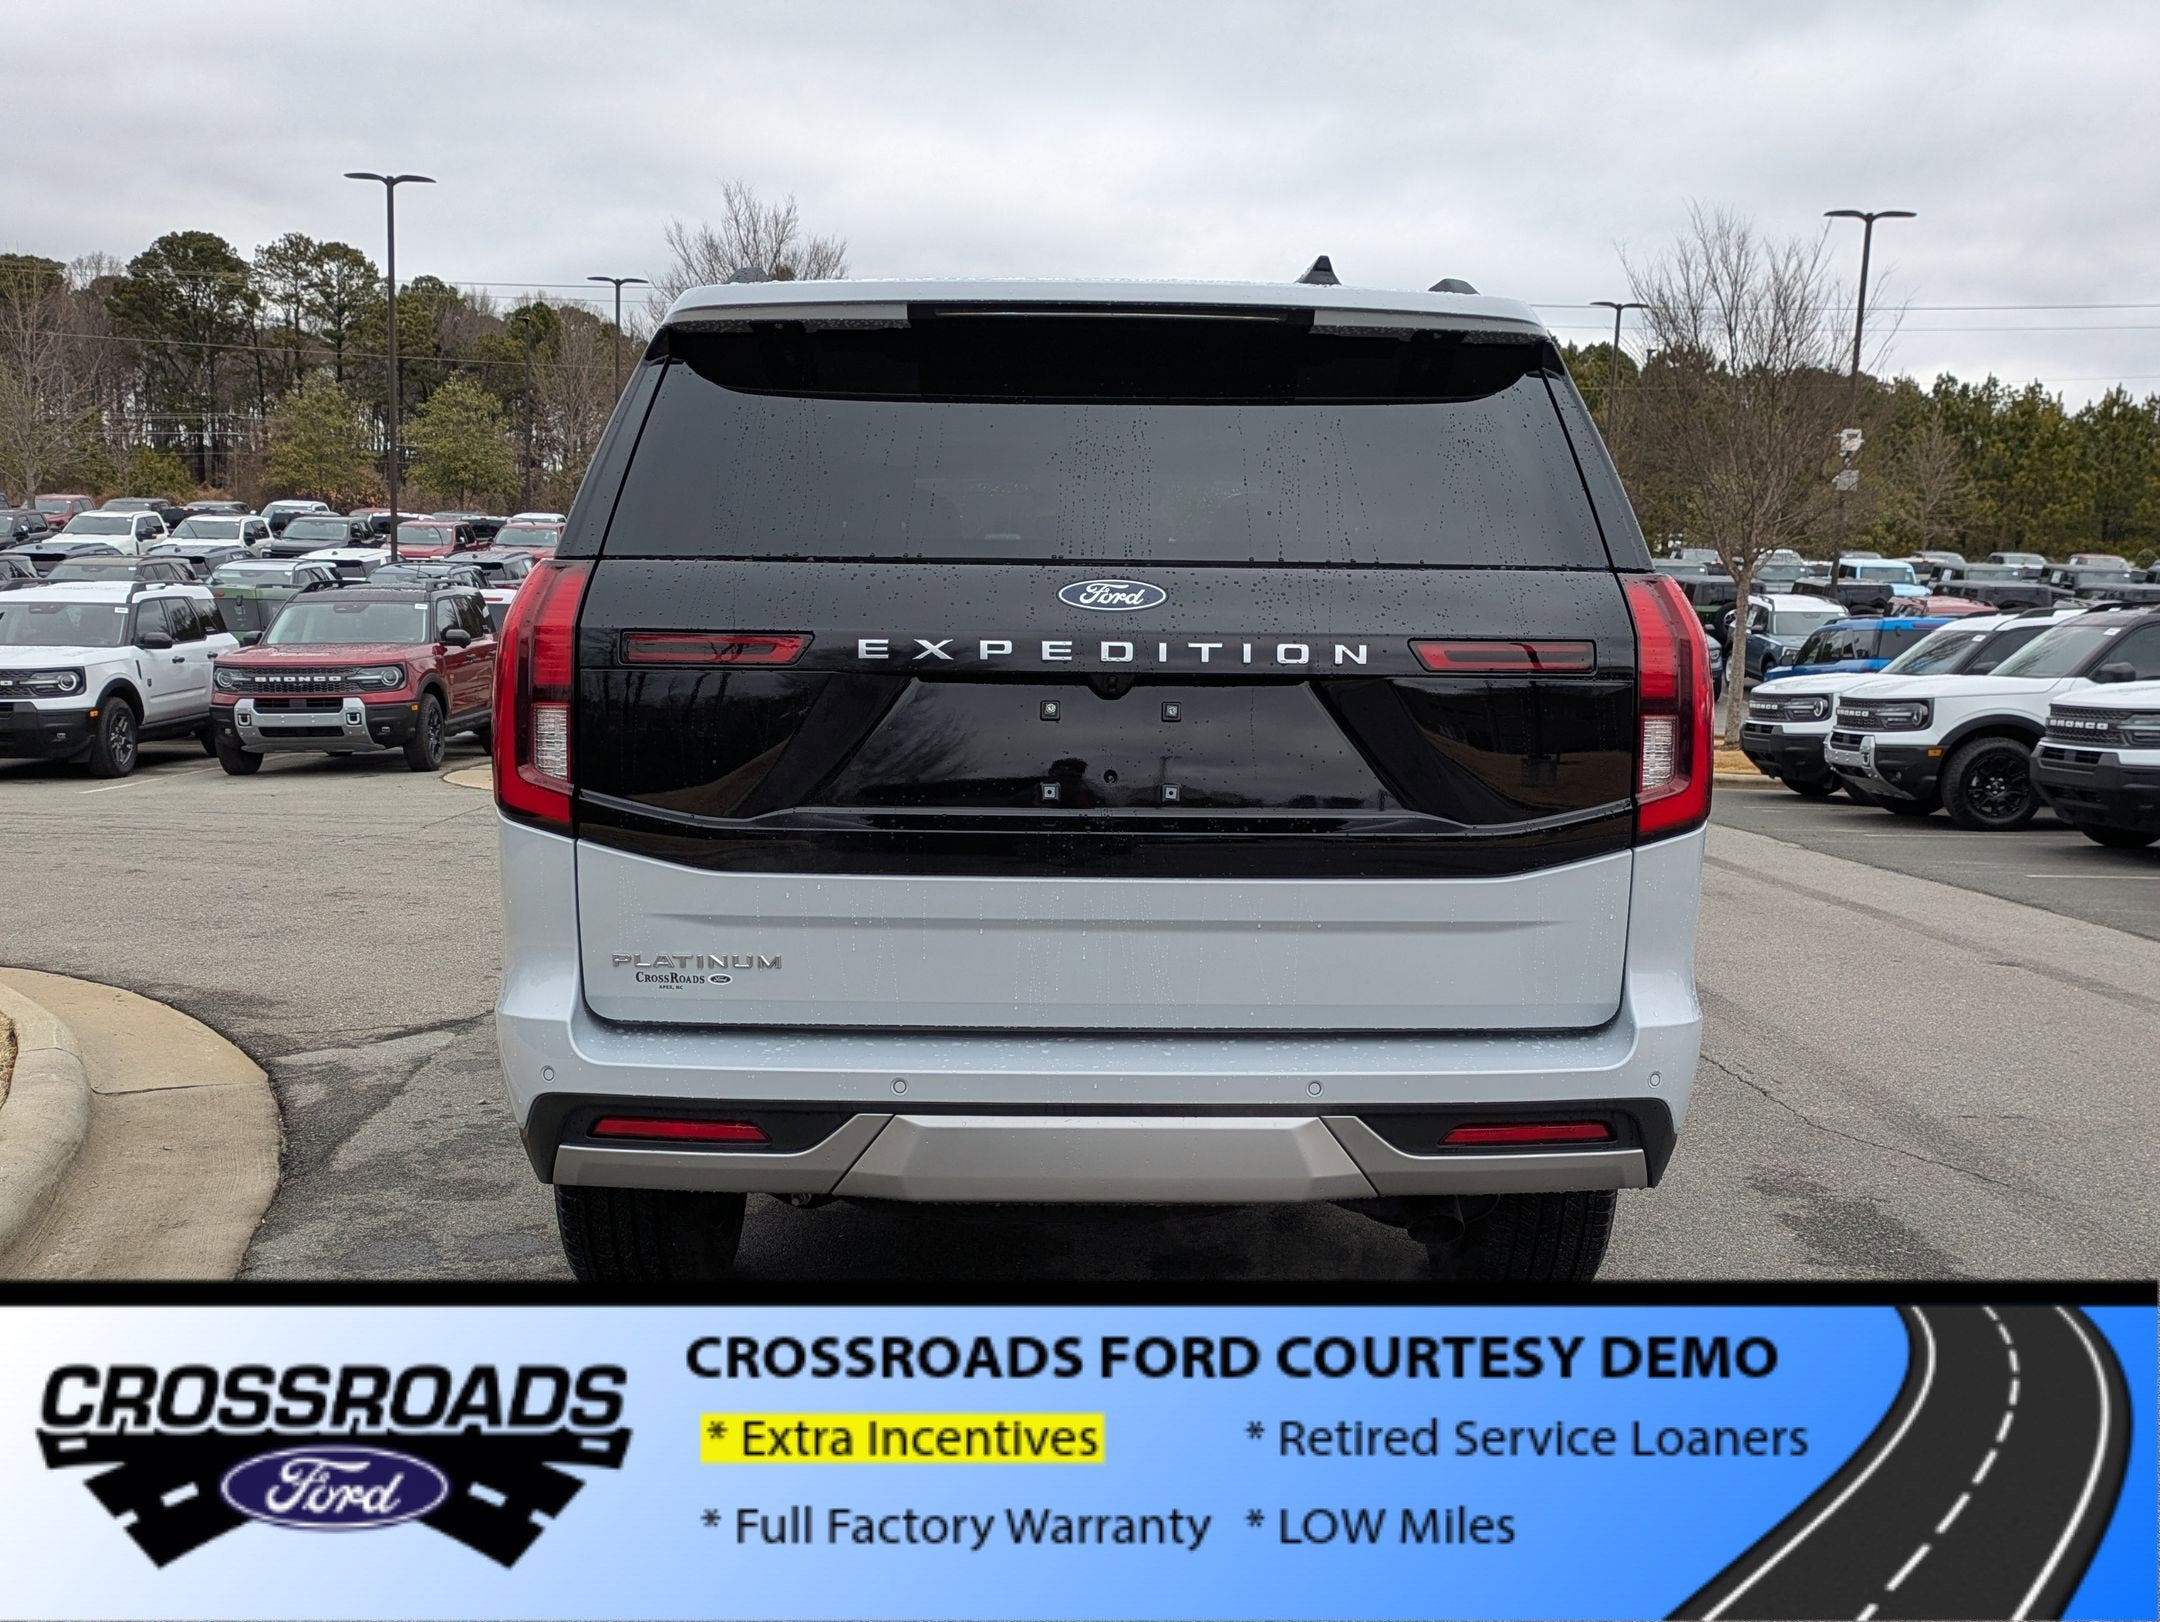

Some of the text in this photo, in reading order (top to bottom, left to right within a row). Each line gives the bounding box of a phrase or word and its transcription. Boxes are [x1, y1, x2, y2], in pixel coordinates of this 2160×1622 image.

[1079, 582, 1146, 605] Ford
[857, 637, 1368, 665] EXPEDITION
[254, 675, 342, 683] BRONCO
[2049, 719, 2109, 731] BRONCO
[611, 952, 783, 970] PLATINUM
